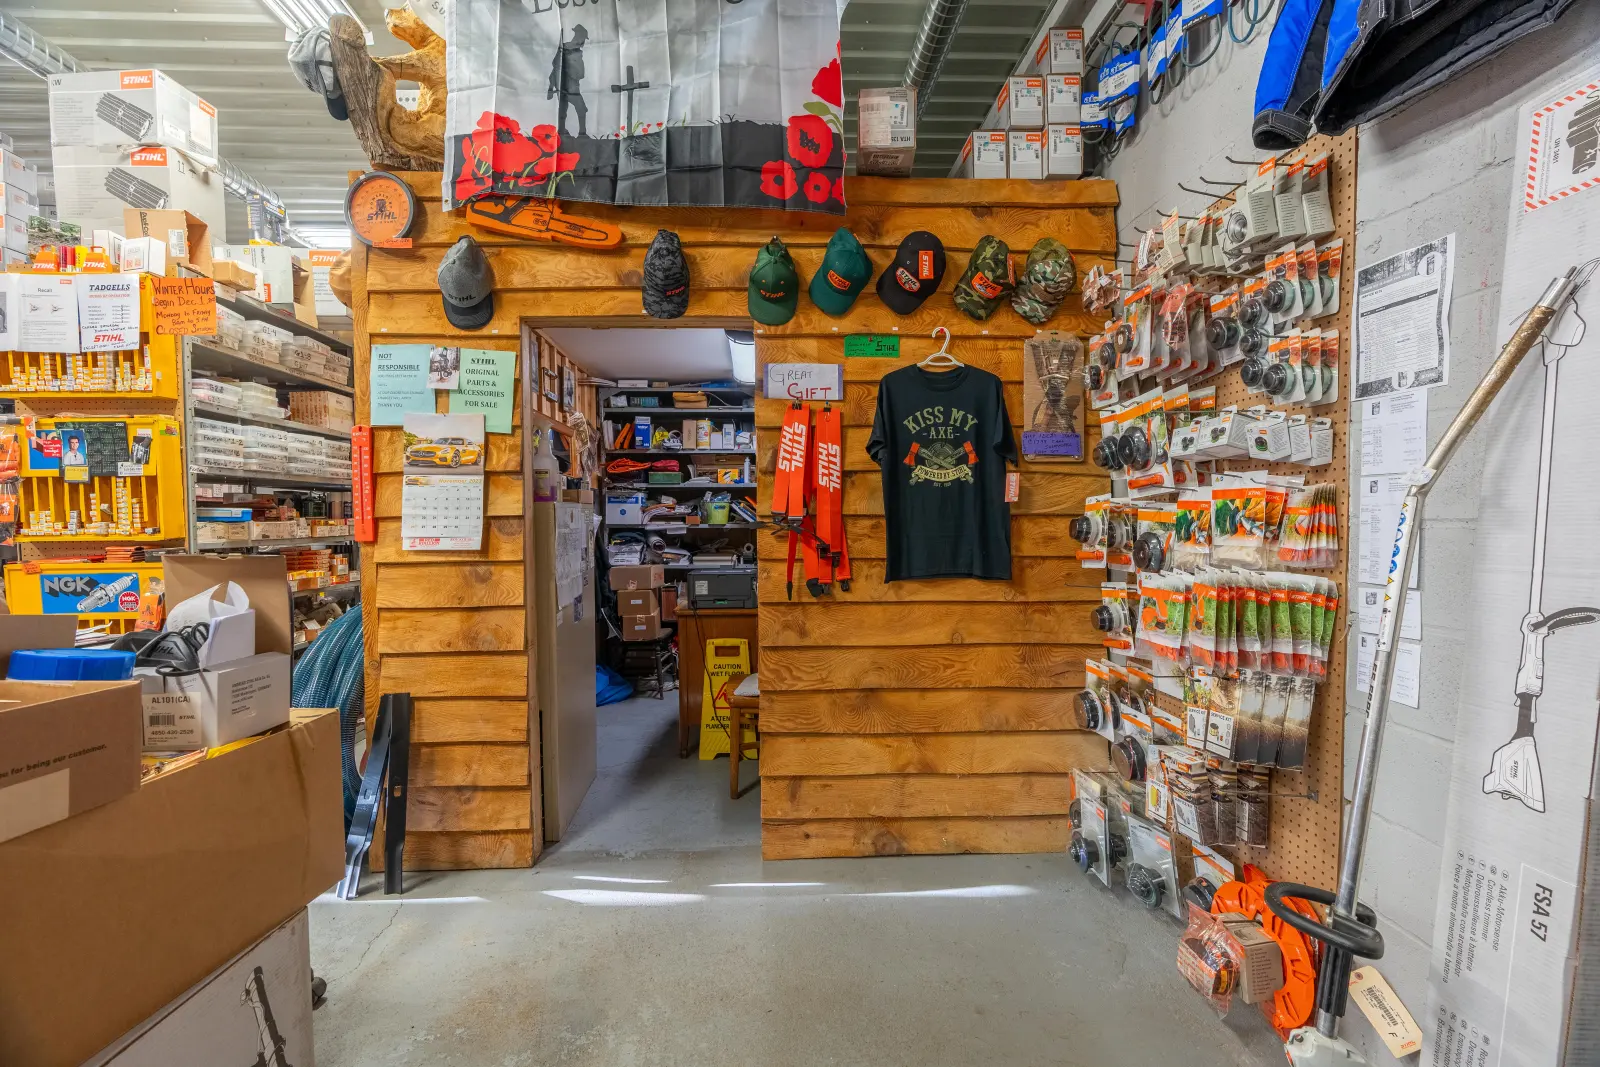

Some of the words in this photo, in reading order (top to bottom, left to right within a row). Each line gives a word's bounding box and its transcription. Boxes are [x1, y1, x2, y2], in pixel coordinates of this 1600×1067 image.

[123, 76, 150, 84] STIHL
[133, 152, 163, 160] STIHL
[367, 212, 397, 221] STIHL
[922, 254, 930, 278] STIHL
[900, 268, 920, 289] STIHL
[447, 292, 477, 302] STIHL
[666, 286, 686, 296] STIHL
[760, 290, 785, 298] STIHL
[154, 298, 174, 309] Begin
[94, 334, 124, 342] STIHL
[770, 364, 813, 386] GREAT
[459, 389, 504, 398] ACCESSORIES
[788, 383, 832, 400] GIFT
[903, 406, 944, 434] KISS
[950, 408, 978, 432] MY
[778, 426, 794, 472] STIHL
[792, 422, 806, 472] STIHL
[828, 442, 840, 492] STIHL
[918, 466, 943, 481] POWERED
[44, 577, 91, 593] NGK
[1210, 712, 1225, 720] SERVICE
[11, 766, 24, 774] for
[26, 758, 51, 772] being
[52, 754, 67, 762] our
[68, 742, 108, 757] customer.
[1455, 863, 1463, 884] Foice
[1450, 890, 1458, 912] motor
[1485, 879, 1496, 912] Cordless
[1534, 883, 1552, 916] FSA
[1530, 919, 1548, 942] 57
[1466, 942, 1477, 972] batterie
[1444, 1025, 1455, 1067] Accu-motor
